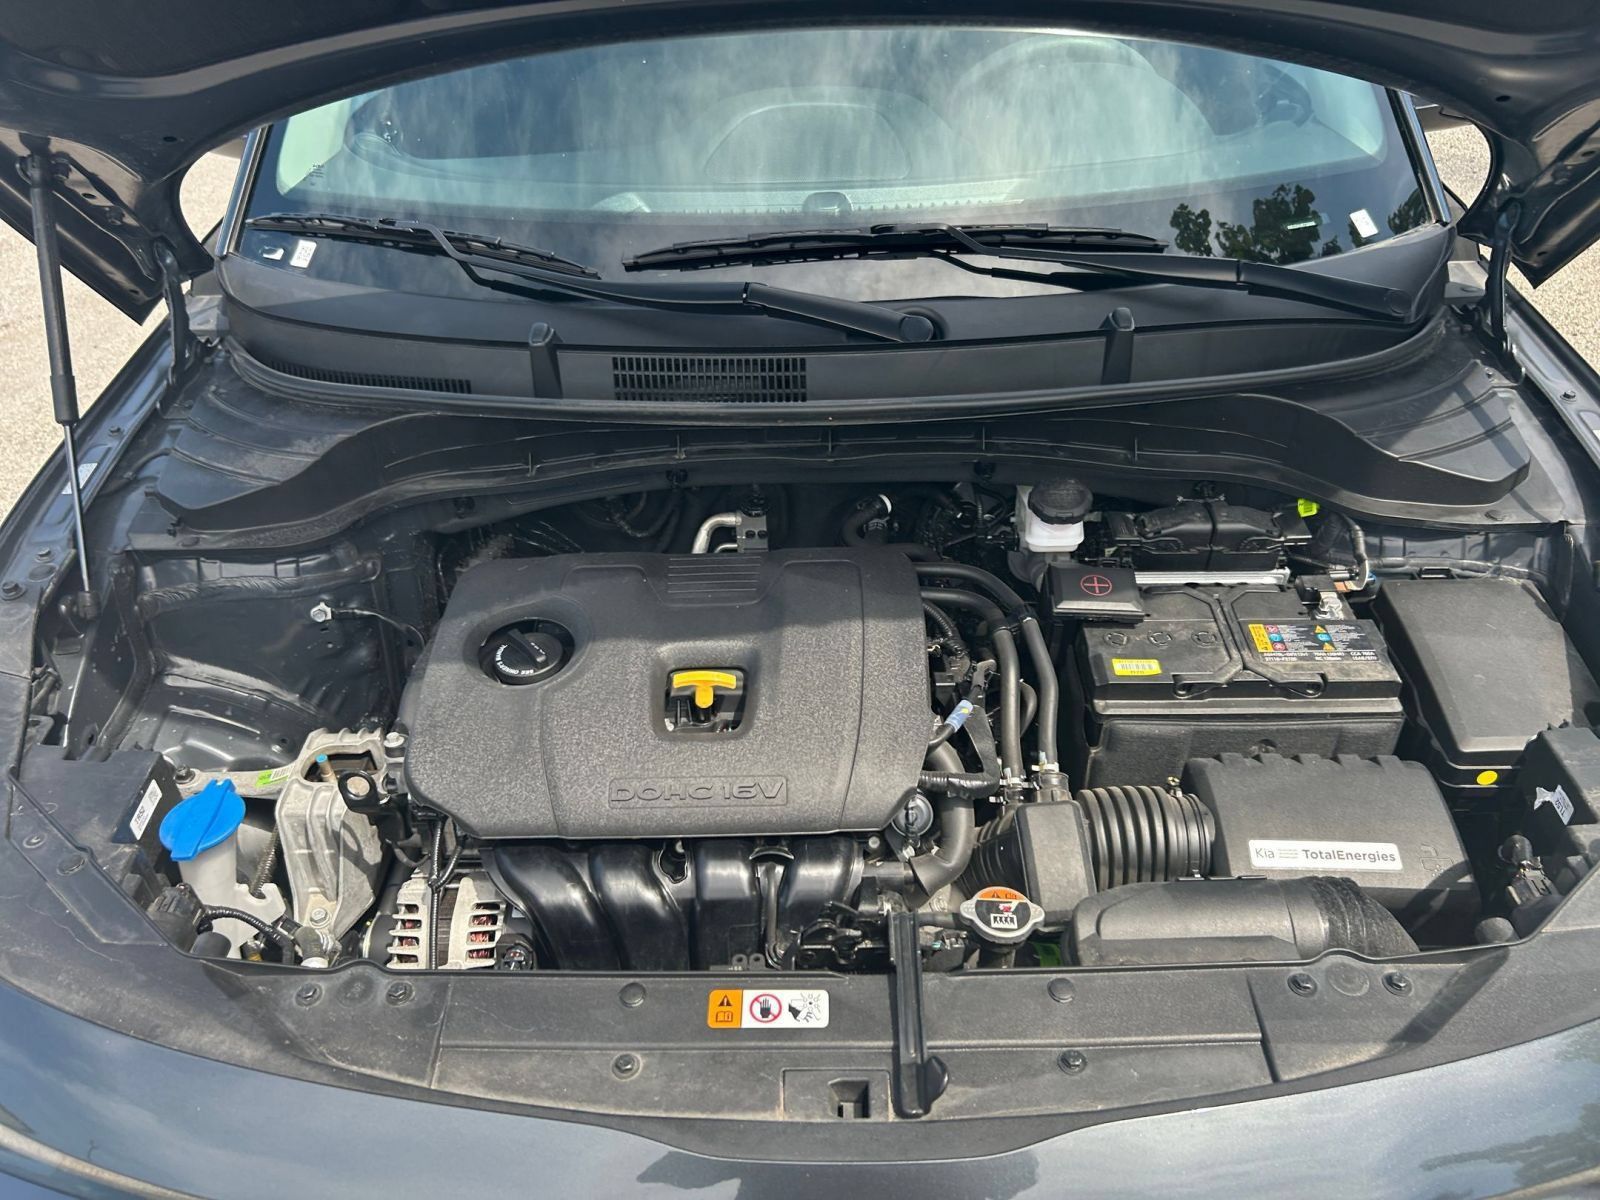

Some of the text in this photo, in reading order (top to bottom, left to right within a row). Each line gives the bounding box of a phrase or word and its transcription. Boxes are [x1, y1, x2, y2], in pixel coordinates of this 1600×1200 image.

[610, 782, 784, 801] DOHC 16V
[1255, 848, 1275, 859] Kia
[1302, 849, 1396, 863] TotalEnergies
